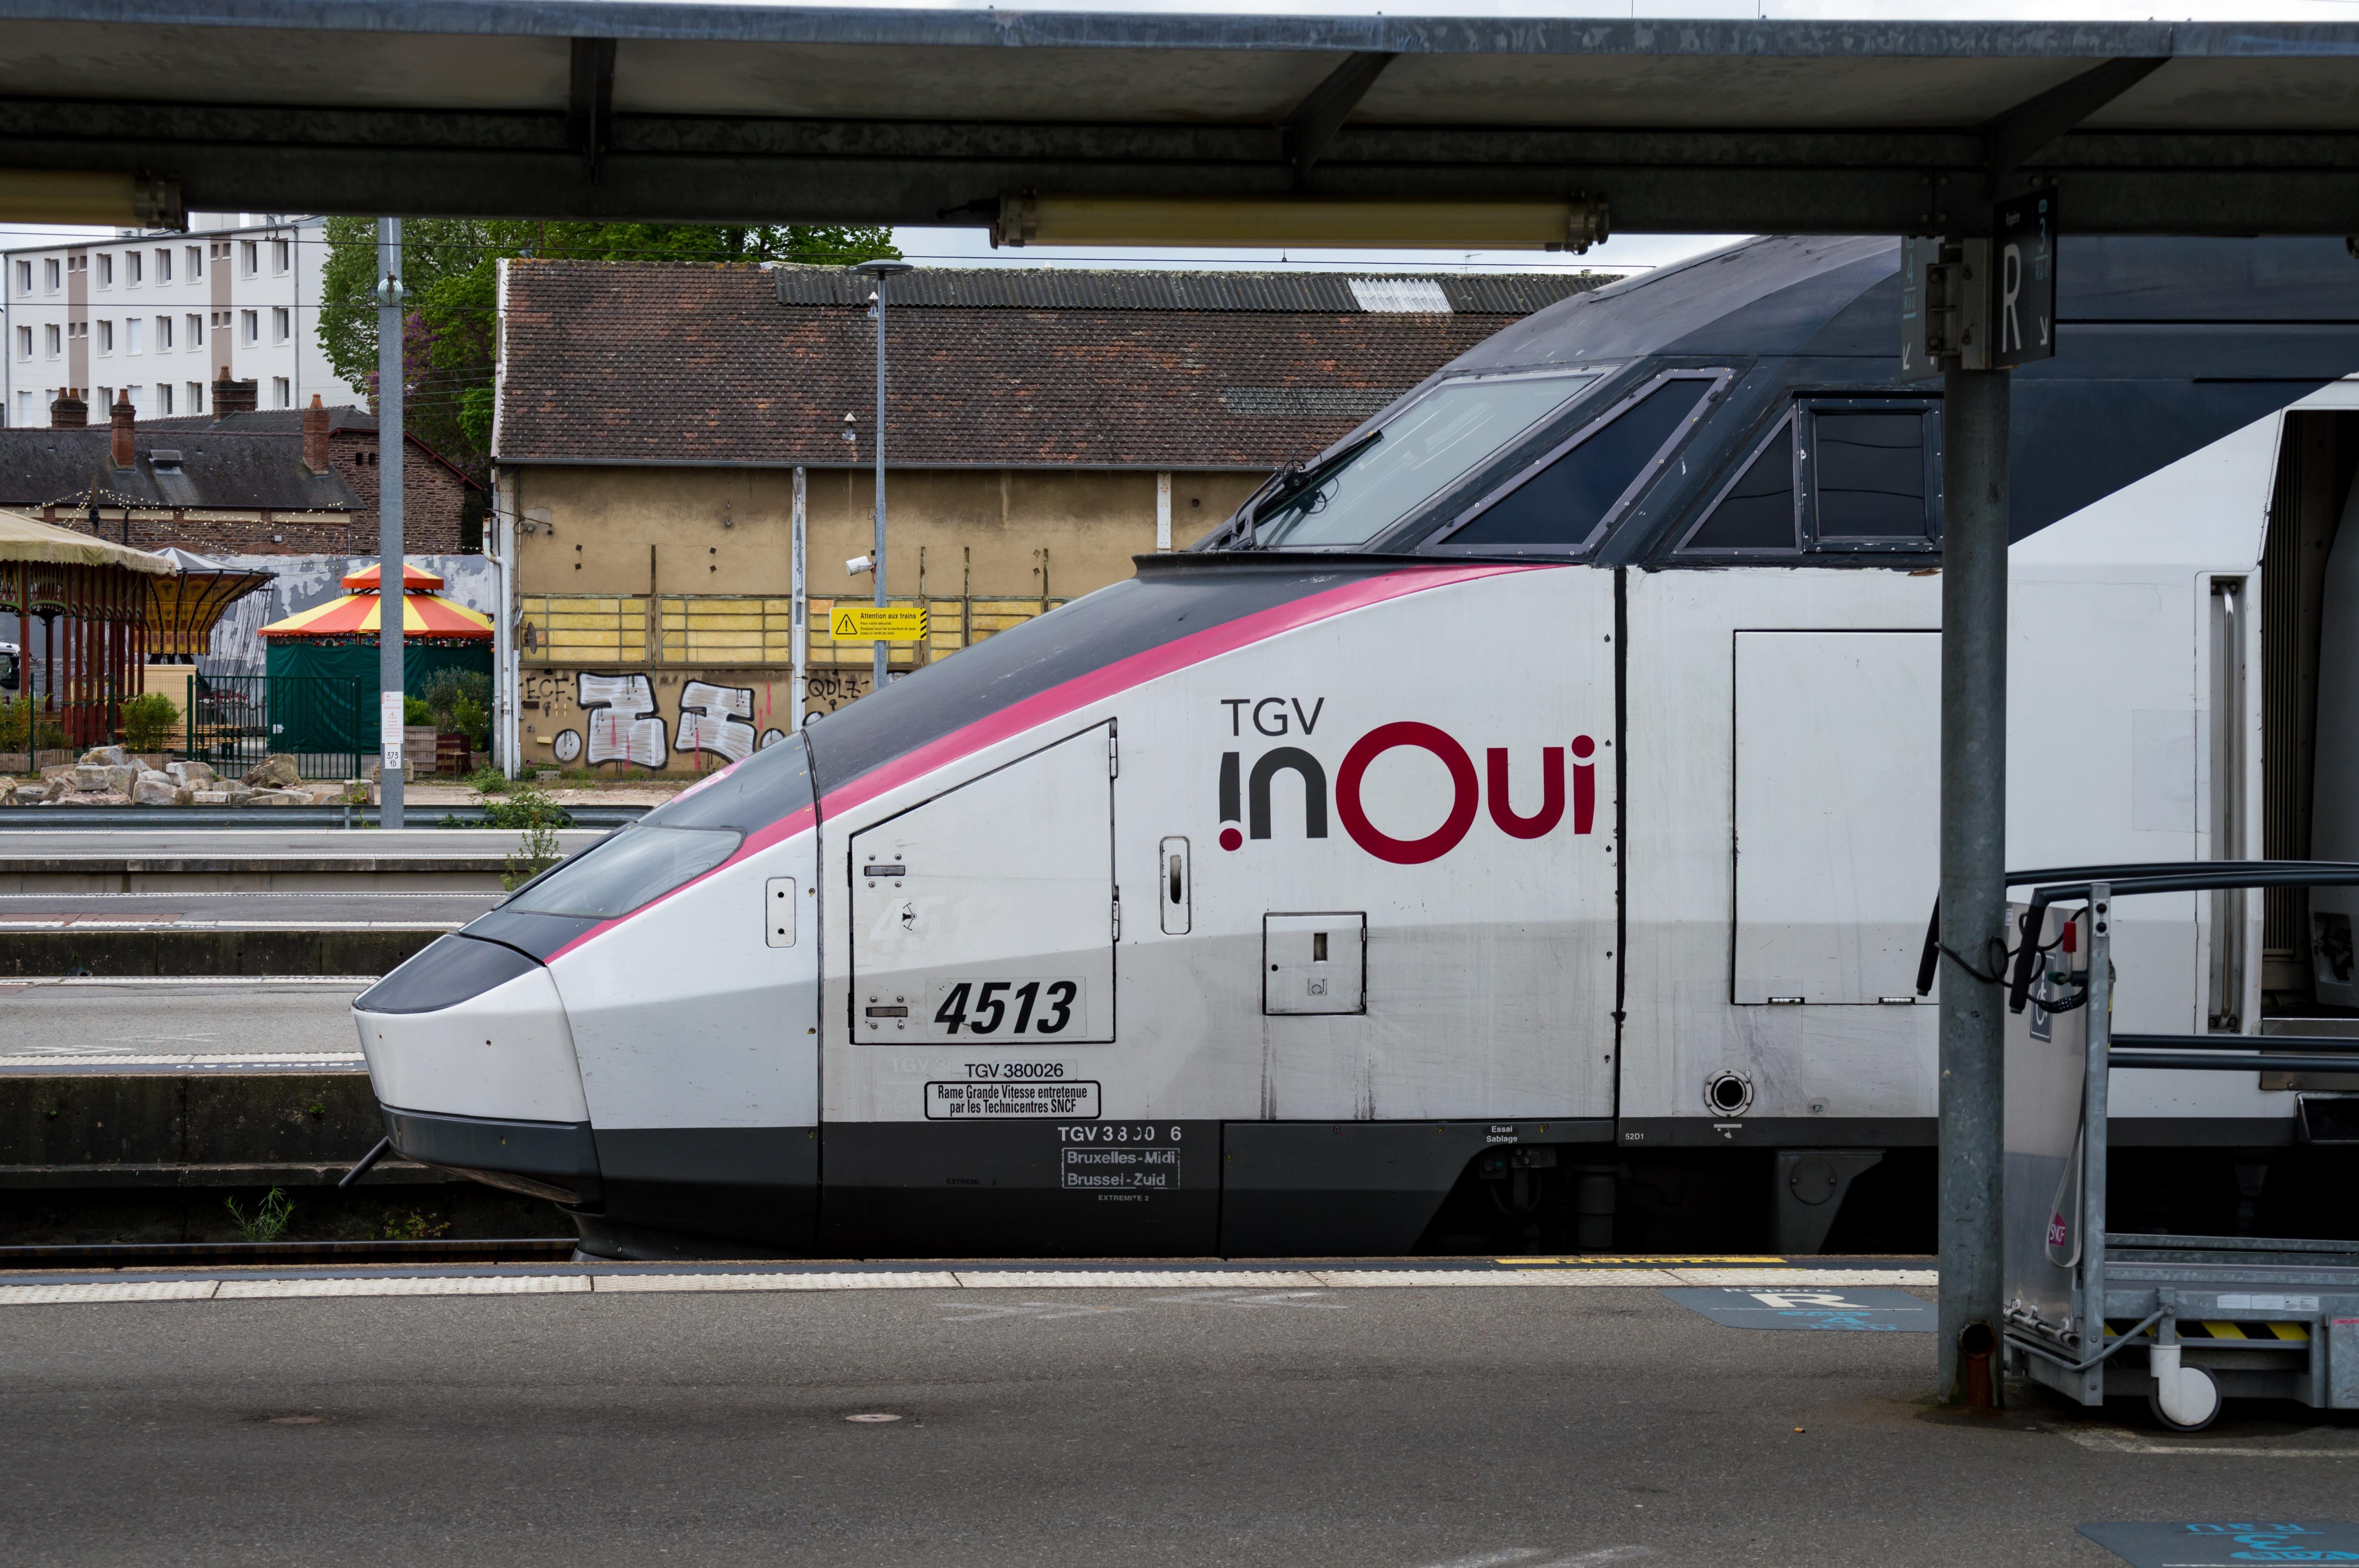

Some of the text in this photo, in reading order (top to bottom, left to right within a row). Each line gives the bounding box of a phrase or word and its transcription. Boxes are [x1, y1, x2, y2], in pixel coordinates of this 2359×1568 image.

[1907, 252, 1914, 285] 4
[2003, 243, 2021, 352] R
[1221, 697, 1325, 737] TGV
[934, 981, 1078, 1034] 4513
[964, 1063, 999, 1078] TGV
[1004, 1063, 1064, 1078] 380026
[938, 1085, 963, 1099] Rame
[967, 1085, 999, 1099] Grande
[1001, 1085, 1035, 1099] Vitesse
[1038, 1086, 1087, 1099] entretenue
[950, 1099, 1076, 1116] par les Technicentres SNCF
[1058, 1126, 1098, 1142] TGV
[1486, 1134, 1518, 1144] Sablage
[2049, 1224, 2065, 1242] SNCF
[1750, 1293, 1871, 1308] R
[2233, 1535, 2306, 1550] 3
